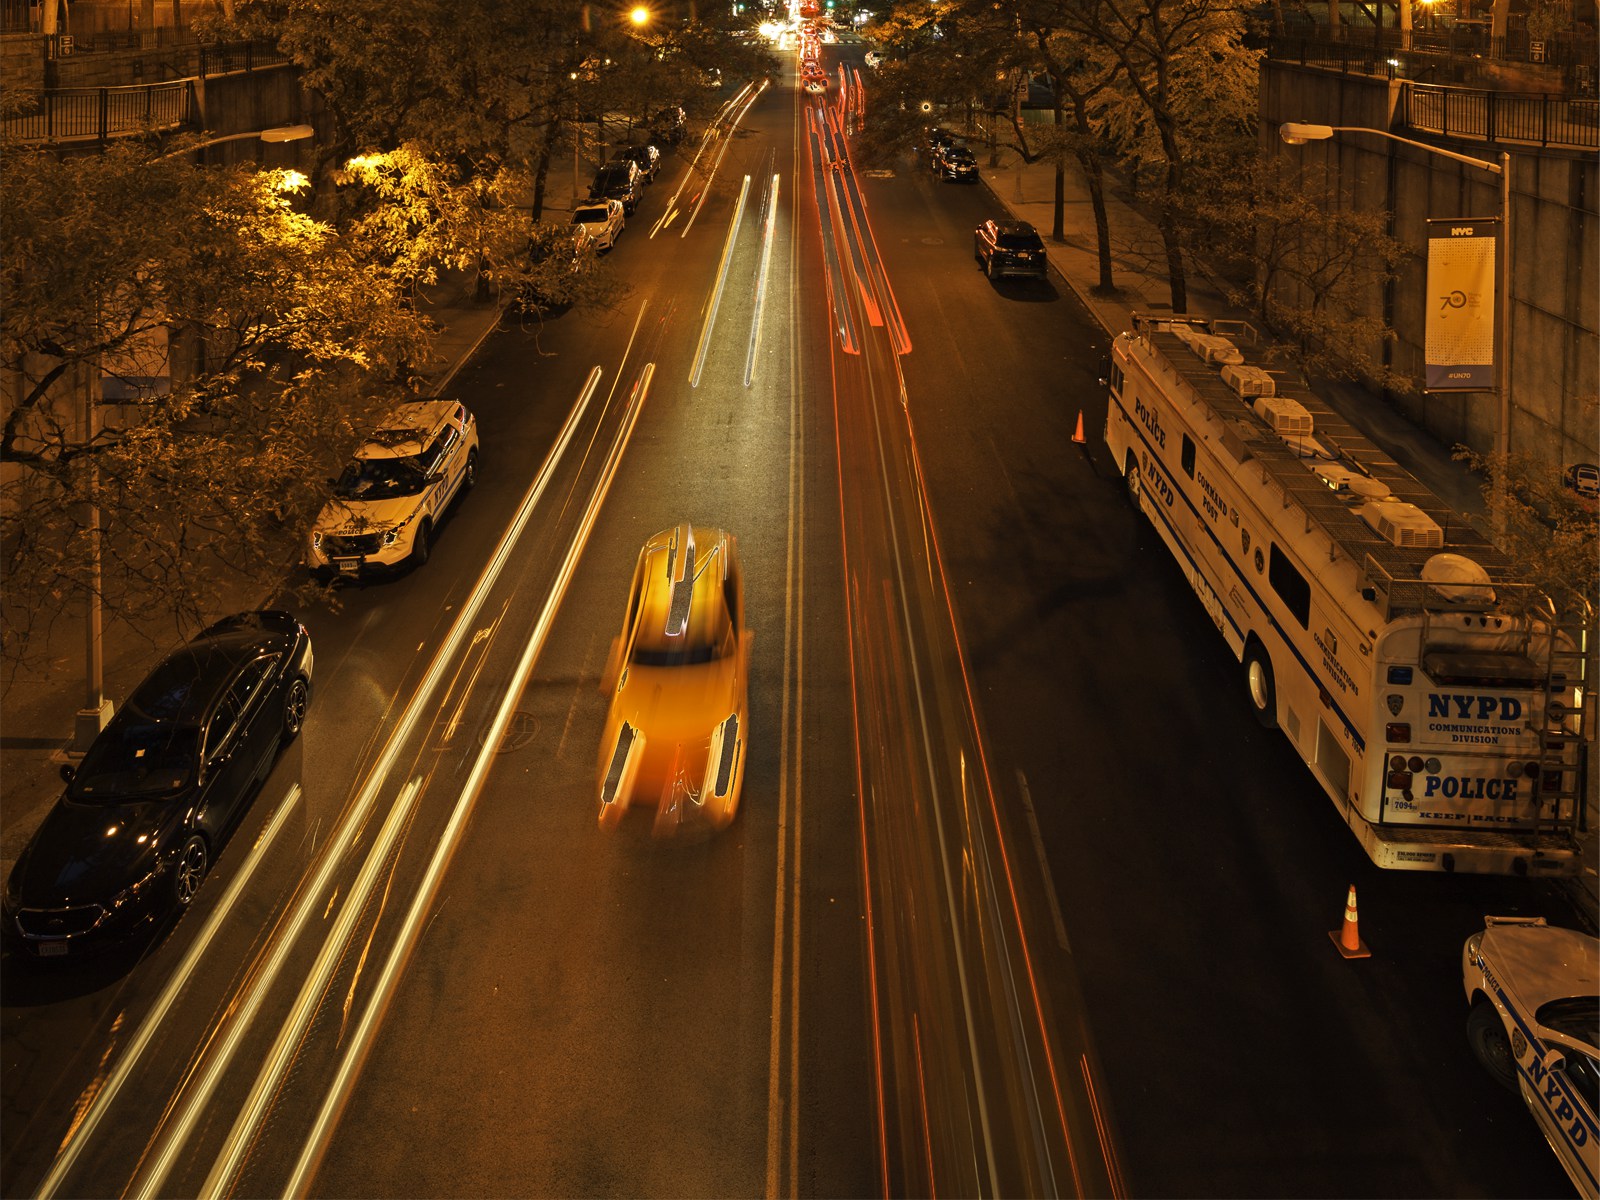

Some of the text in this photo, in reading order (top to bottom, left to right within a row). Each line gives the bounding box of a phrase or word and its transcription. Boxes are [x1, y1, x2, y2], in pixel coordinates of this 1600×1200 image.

[1451, 227, 1473, 236] NYC
[1135, 396, 1166, 450] POLICE
[1147, 462, 1174, 507] NYPD
[1197, 471, 1228, 516] COMMAND
[1203, 495, 1218, 523] POST
[1313, 632, 1359, 697] COMMUNICATIONS
[1322, 657, 1347, 694] DIVISION
[1428, 693, 1522, 721] NYPD
[1429, 723, 1521, 736] COMMUNICATIONS
[1452, 734, 1499, 745] DIVISION
[1424, 775, 1518, 801] POLICE
[1418, 812, 1521, 824] KEEP BACK
[1482, 965, 1501, 992] POLICE
[1527, 1054, 1588, 1148] NYPD
